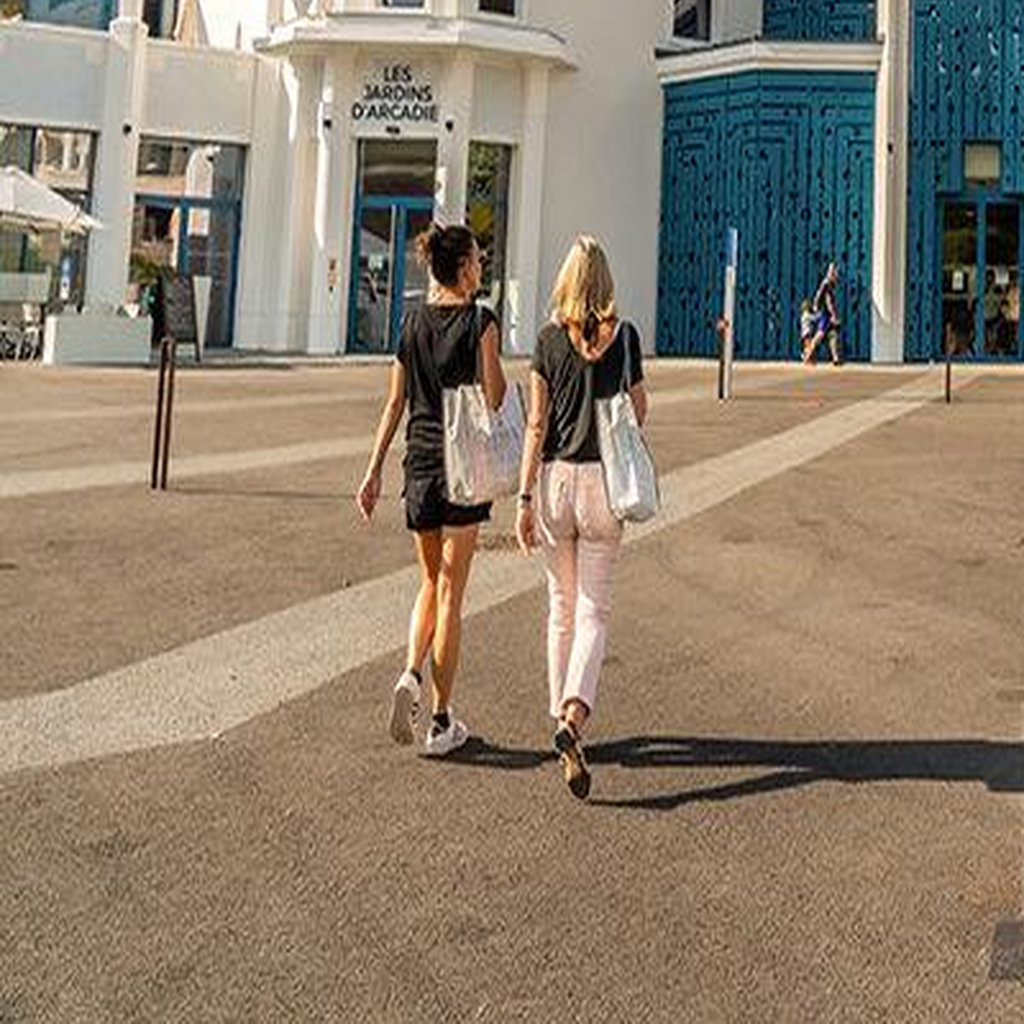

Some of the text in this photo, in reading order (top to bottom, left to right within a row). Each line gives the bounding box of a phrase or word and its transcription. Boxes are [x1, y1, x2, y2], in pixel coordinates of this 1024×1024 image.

[384, 64, 412, 82] LES
[364, 84, 432, 102] JARDINS
[352, 102, 438, 123] D'ARCADIE
